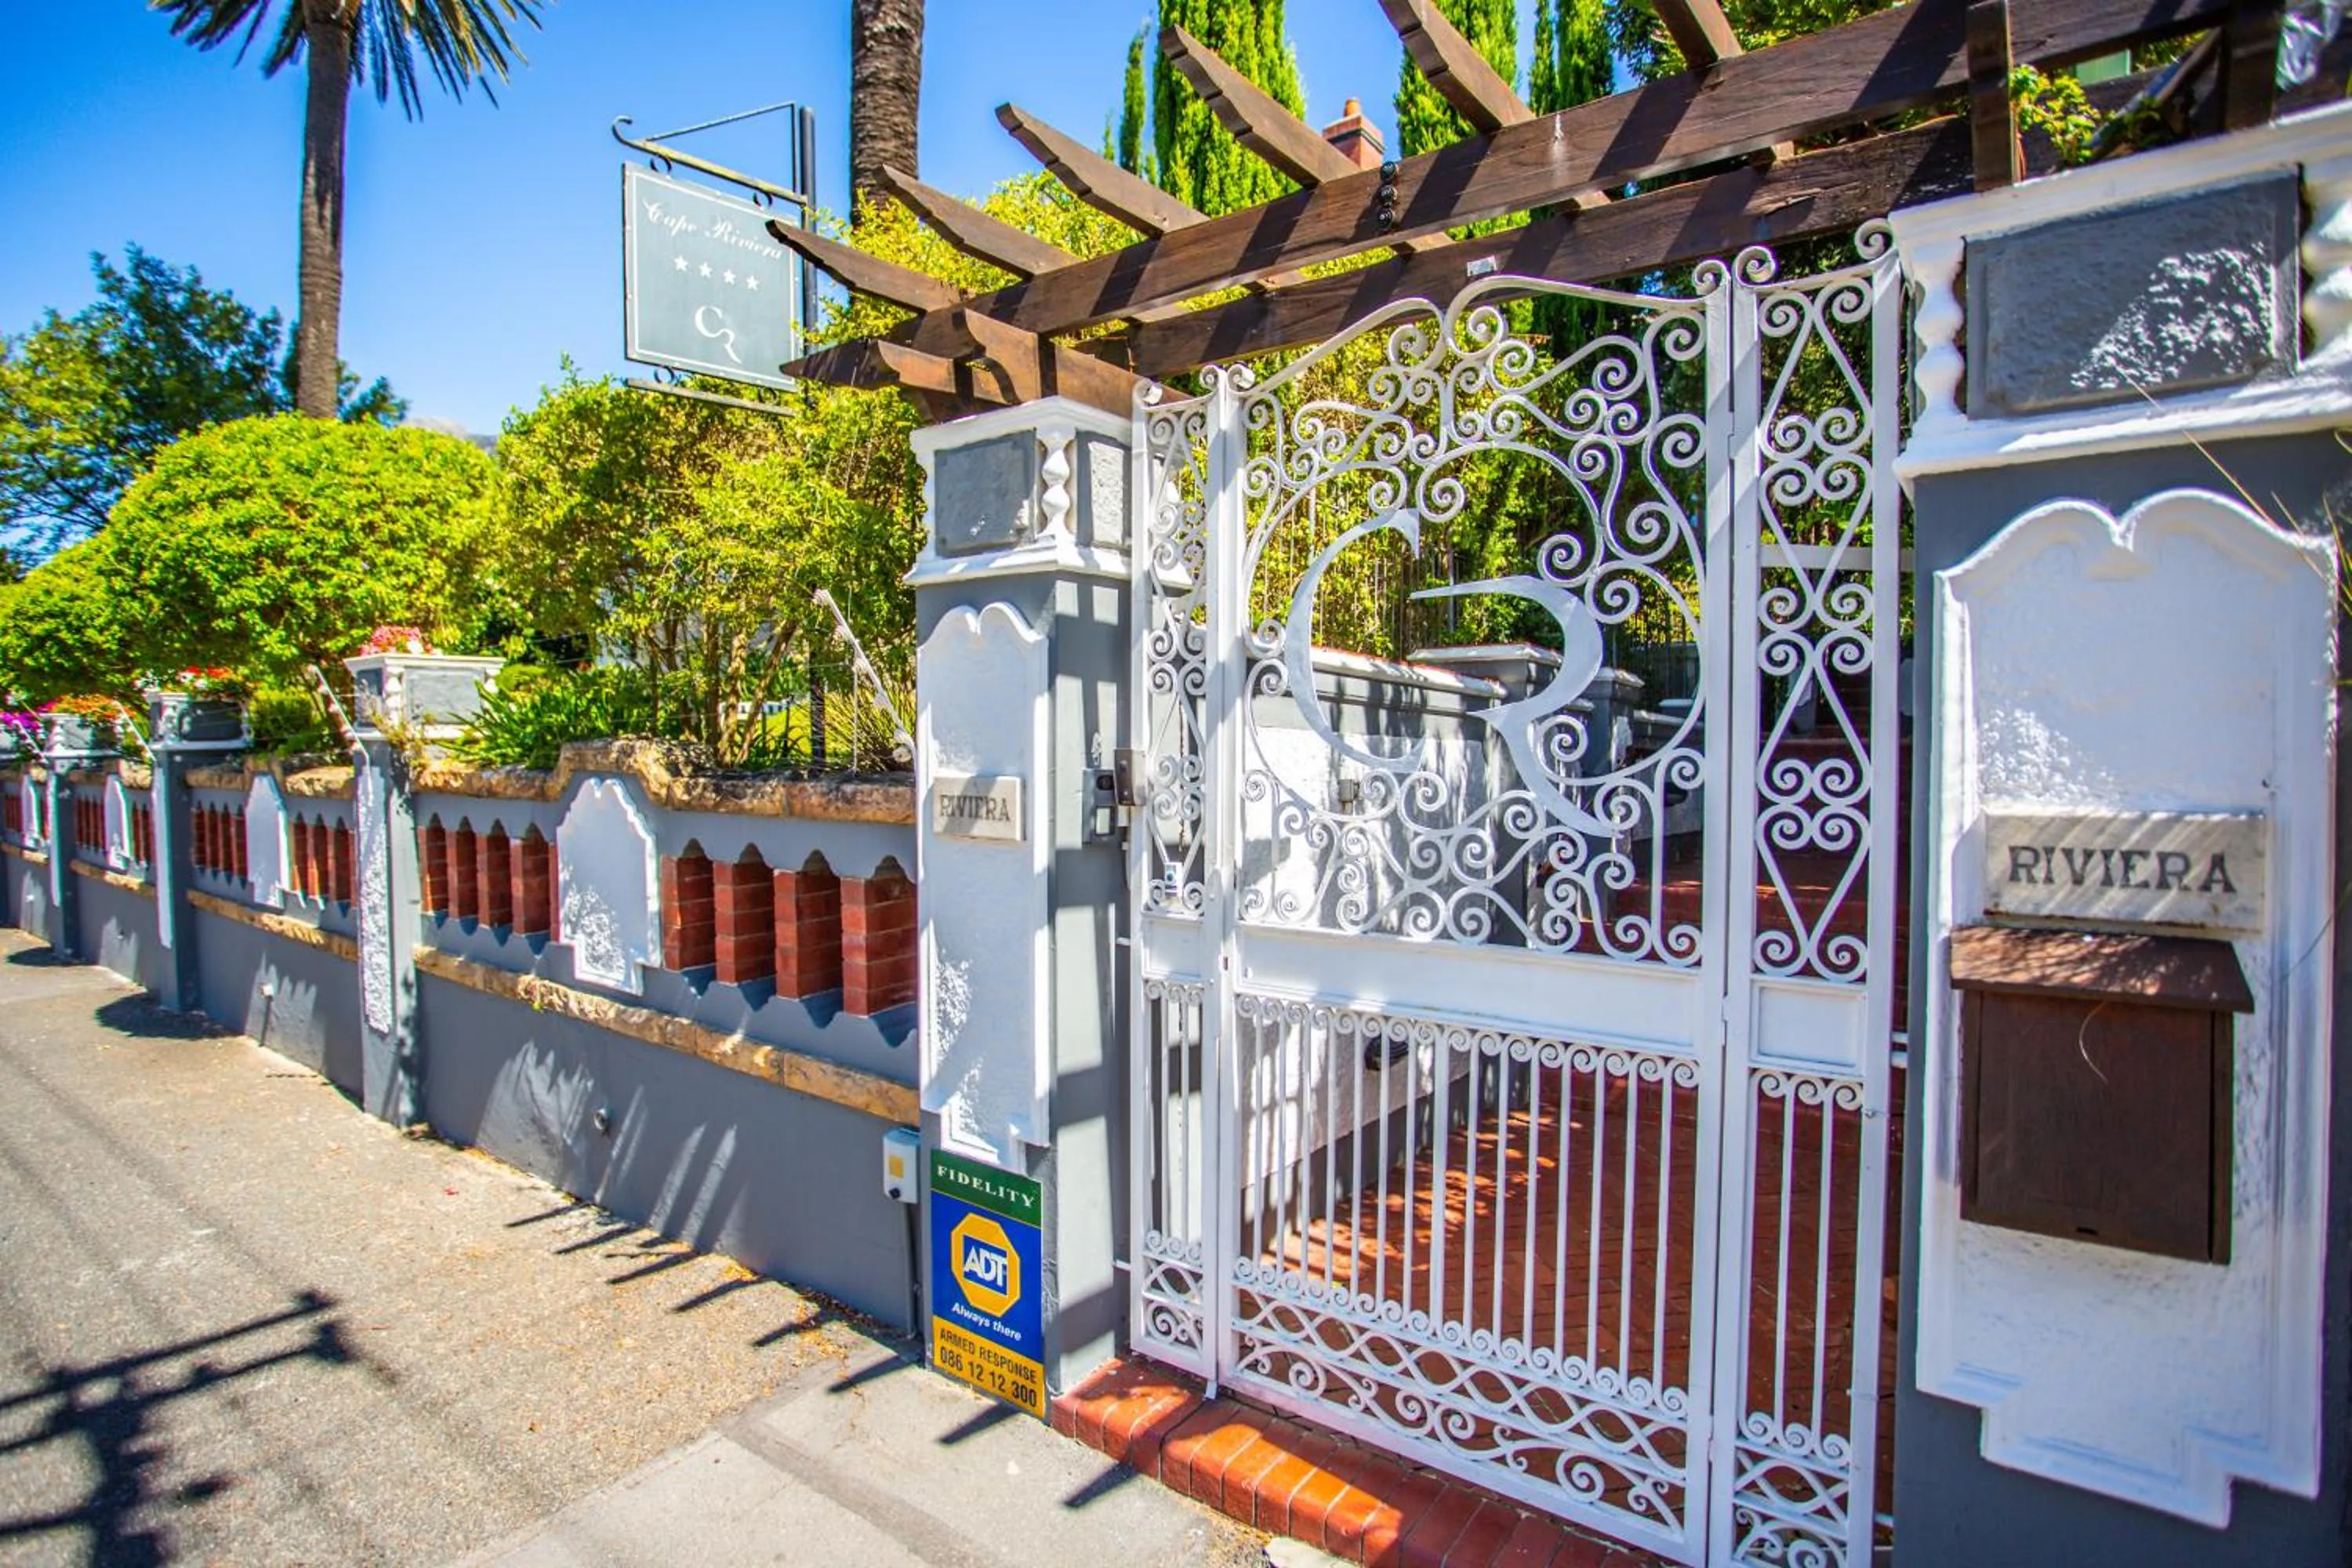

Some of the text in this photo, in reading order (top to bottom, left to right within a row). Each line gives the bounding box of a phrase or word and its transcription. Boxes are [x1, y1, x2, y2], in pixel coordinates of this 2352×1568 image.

[705, 216, 782, 260] Riviera
[939, 794, 1011, 822] RIVIERA
[2008, 845, 2237, 893] RIVIERA
[937, 1165, 1034, 1207] FIDELITY
[964, 1246, 1007, 1287] ADT
[952, 1302, 1022, 1341] Always there
[940, 1327, 1037, 1384] ARMED RESPONSE
[940, 1346, 1037, 1407] 086 12 12 300
